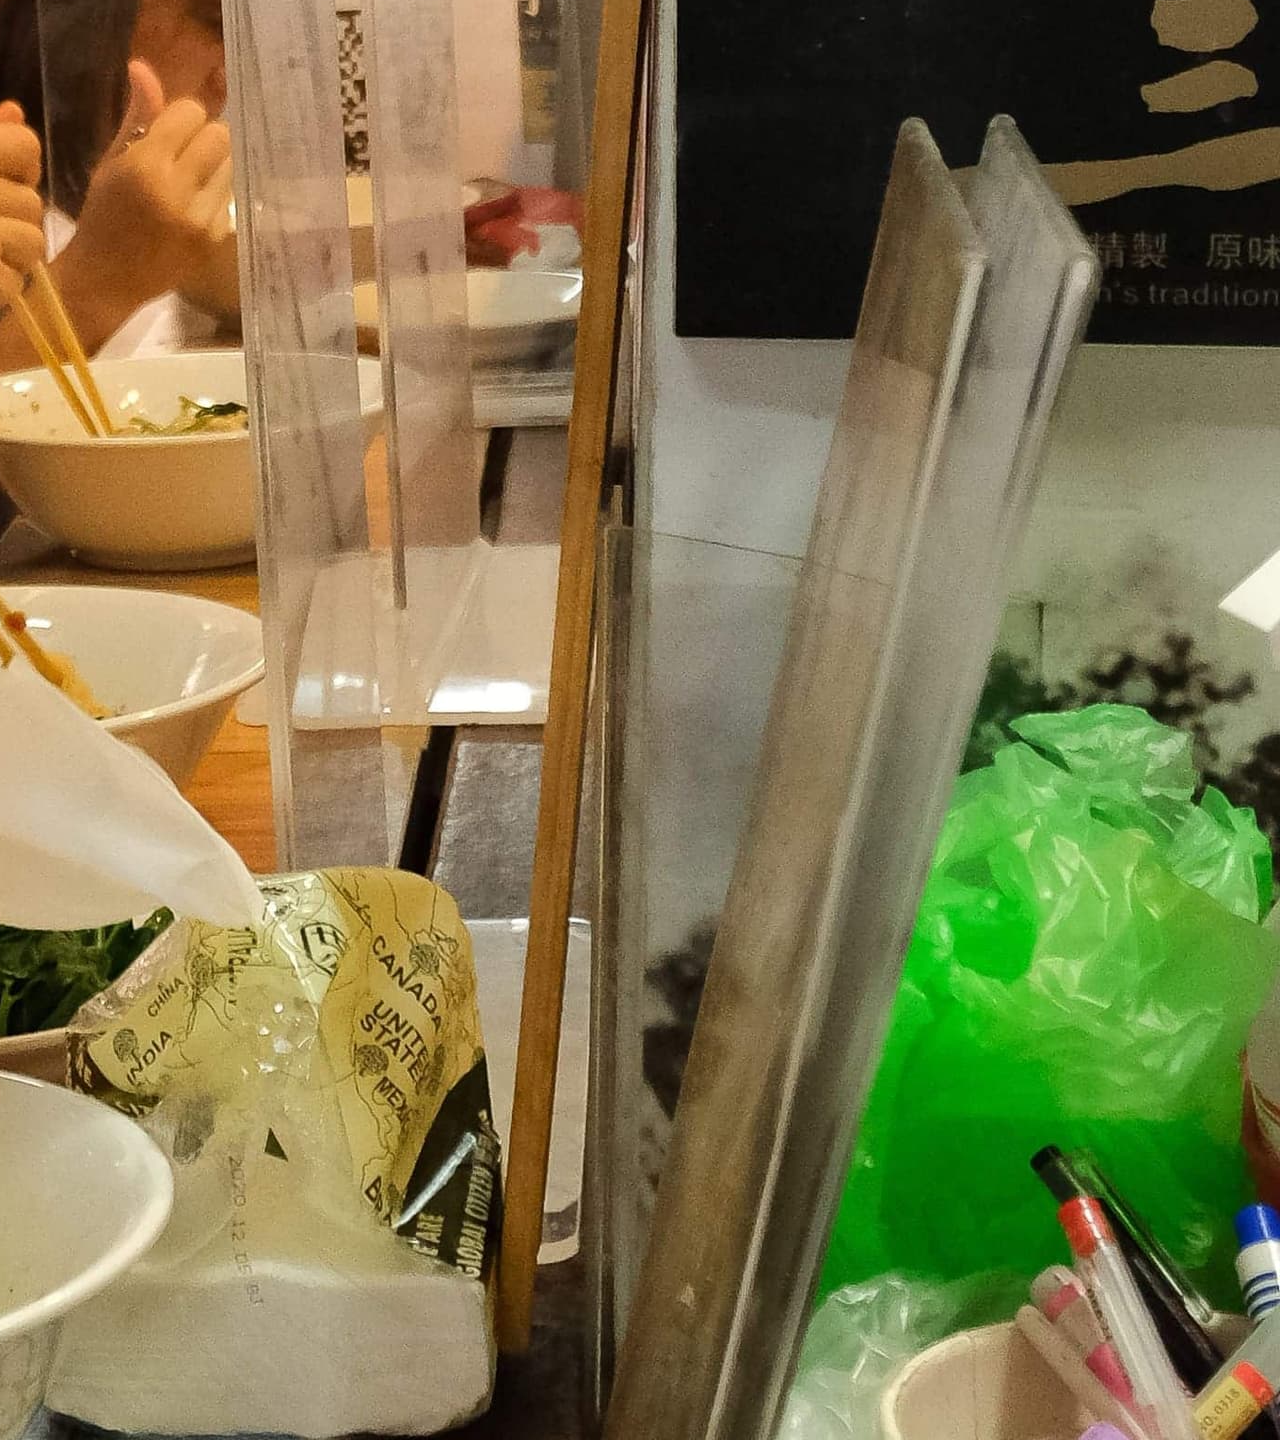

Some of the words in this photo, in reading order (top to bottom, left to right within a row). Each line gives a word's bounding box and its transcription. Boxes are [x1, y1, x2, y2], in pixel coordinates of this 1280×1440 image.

[1206, 233, 1280, 270] 原味
[146, 976, 186, 1019] CHINA
[371, 934, 442, 1034] CANADA
[126, 1030, 173, 1086] INDIA
